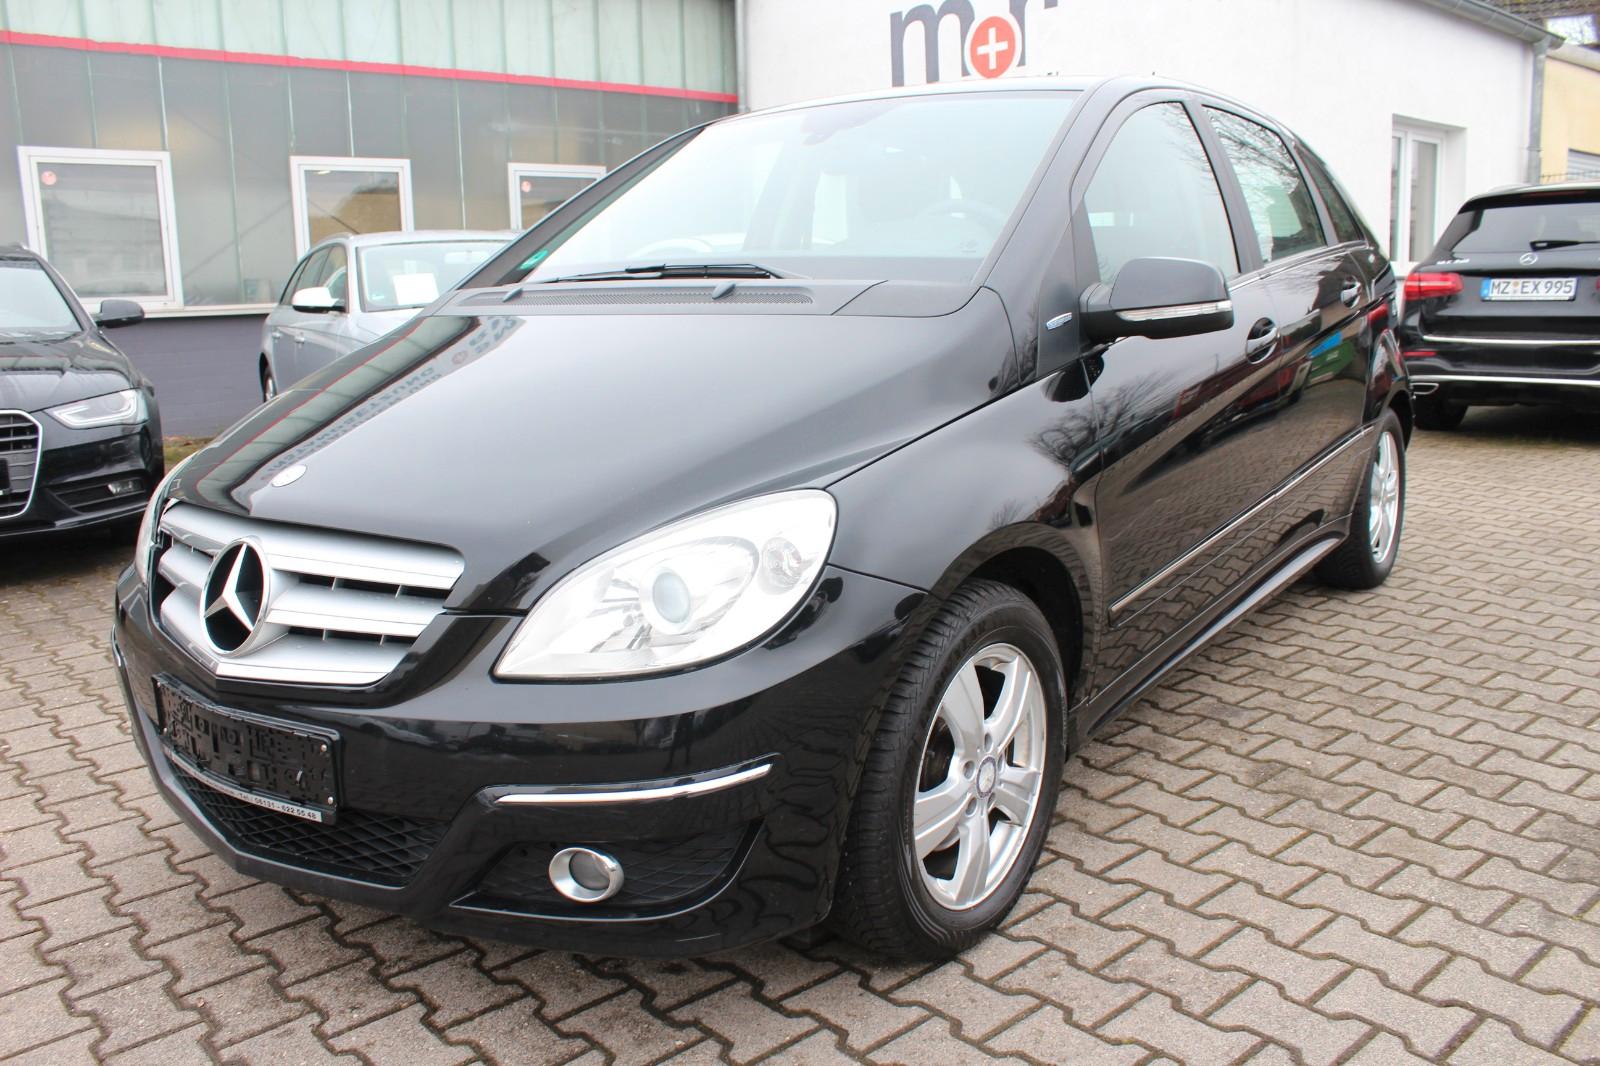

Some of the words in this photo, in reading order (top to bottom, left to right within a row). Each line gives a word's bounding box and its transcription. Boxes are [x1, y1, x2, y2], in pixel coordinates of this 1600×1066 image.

[1491, 281, 1511, 294] MZ
[1520, 280, 1540, 294] EX
[1544, 279, 1573, 294] 995
